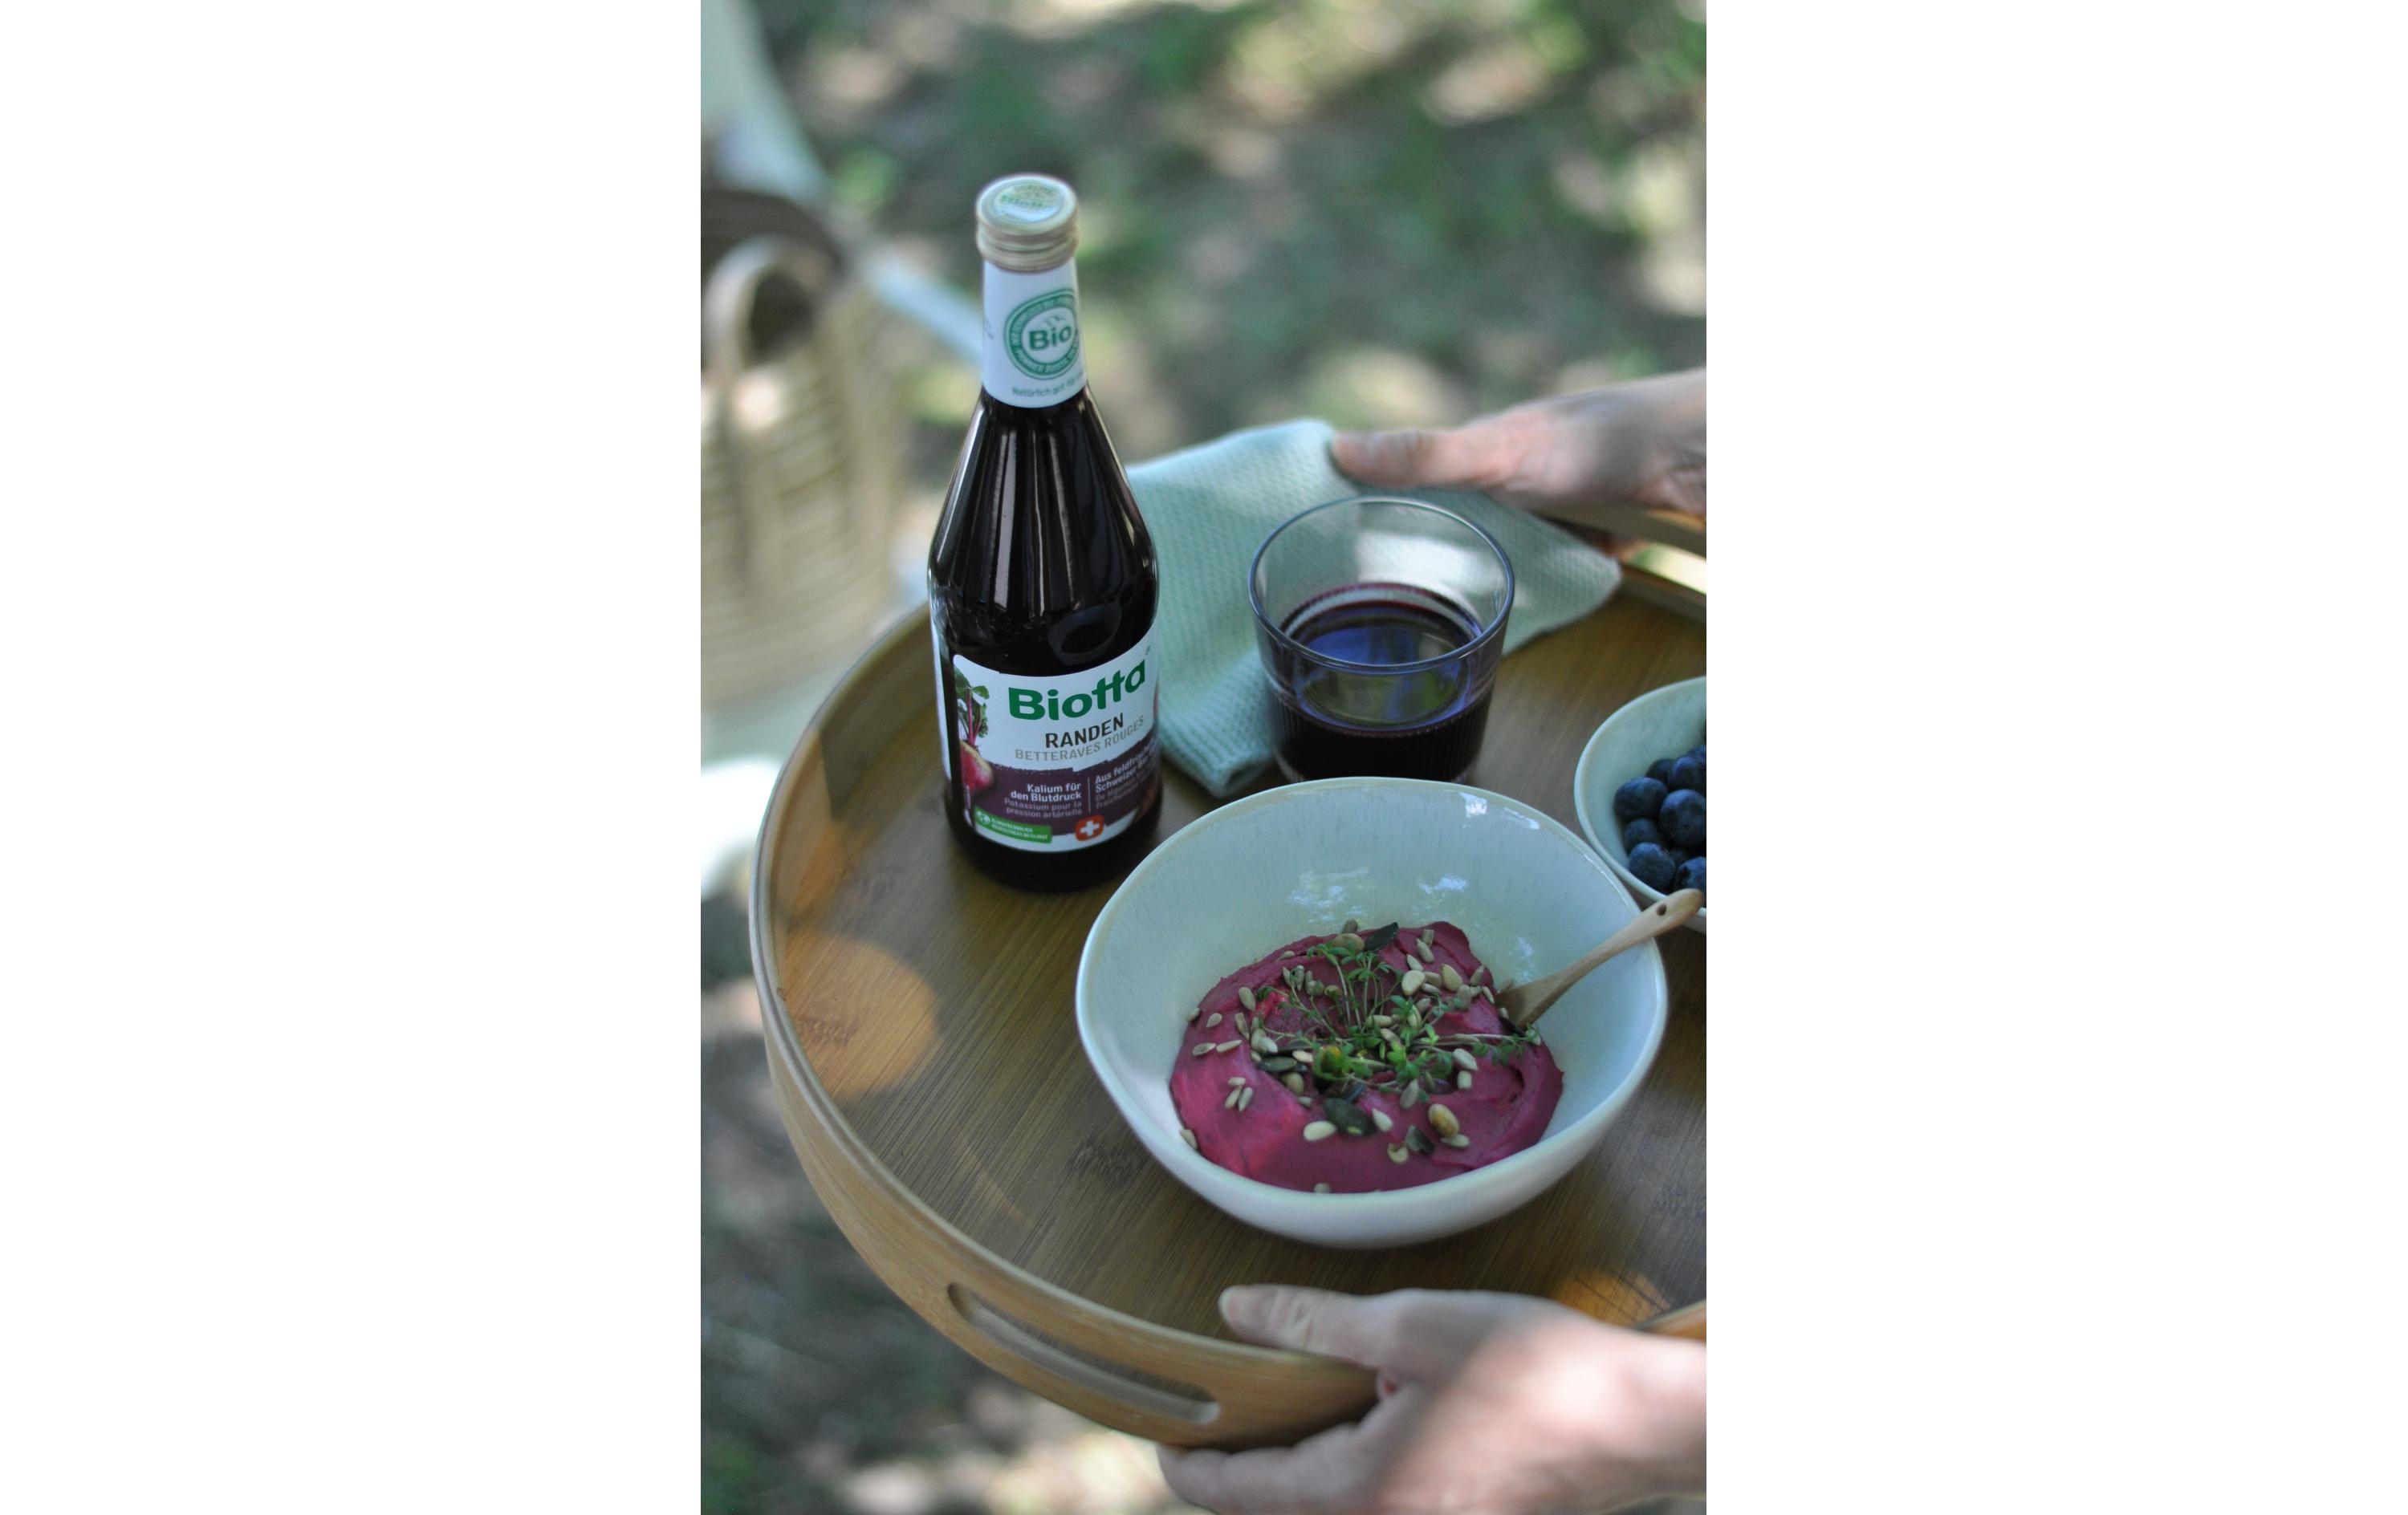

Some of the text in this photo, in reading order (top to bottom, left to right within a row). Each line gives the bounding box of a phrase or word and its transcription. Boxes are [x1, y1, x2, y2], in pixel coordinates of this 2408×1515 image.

[1029, 326, 1072, 351] Bio
[1008, 659, 1145, 721] Biotta
[1015, 715, 1145, 762] BETTERAVES ROUGES
[1046, 713, 1124, 748] RANDEN
[1027, 782, 1081, 794] Kalium für
[1096, 772, 1112, 785] Aus
[1096, 766, 1137, 793] Schweizer
[1004, 798, 1049, 810] Potassium
[1052, 802, 1071, 811] pour
[1011, 790, 1081, 802] den Blutdruck
[1007, 807, 1082, 818] pression artérielle
